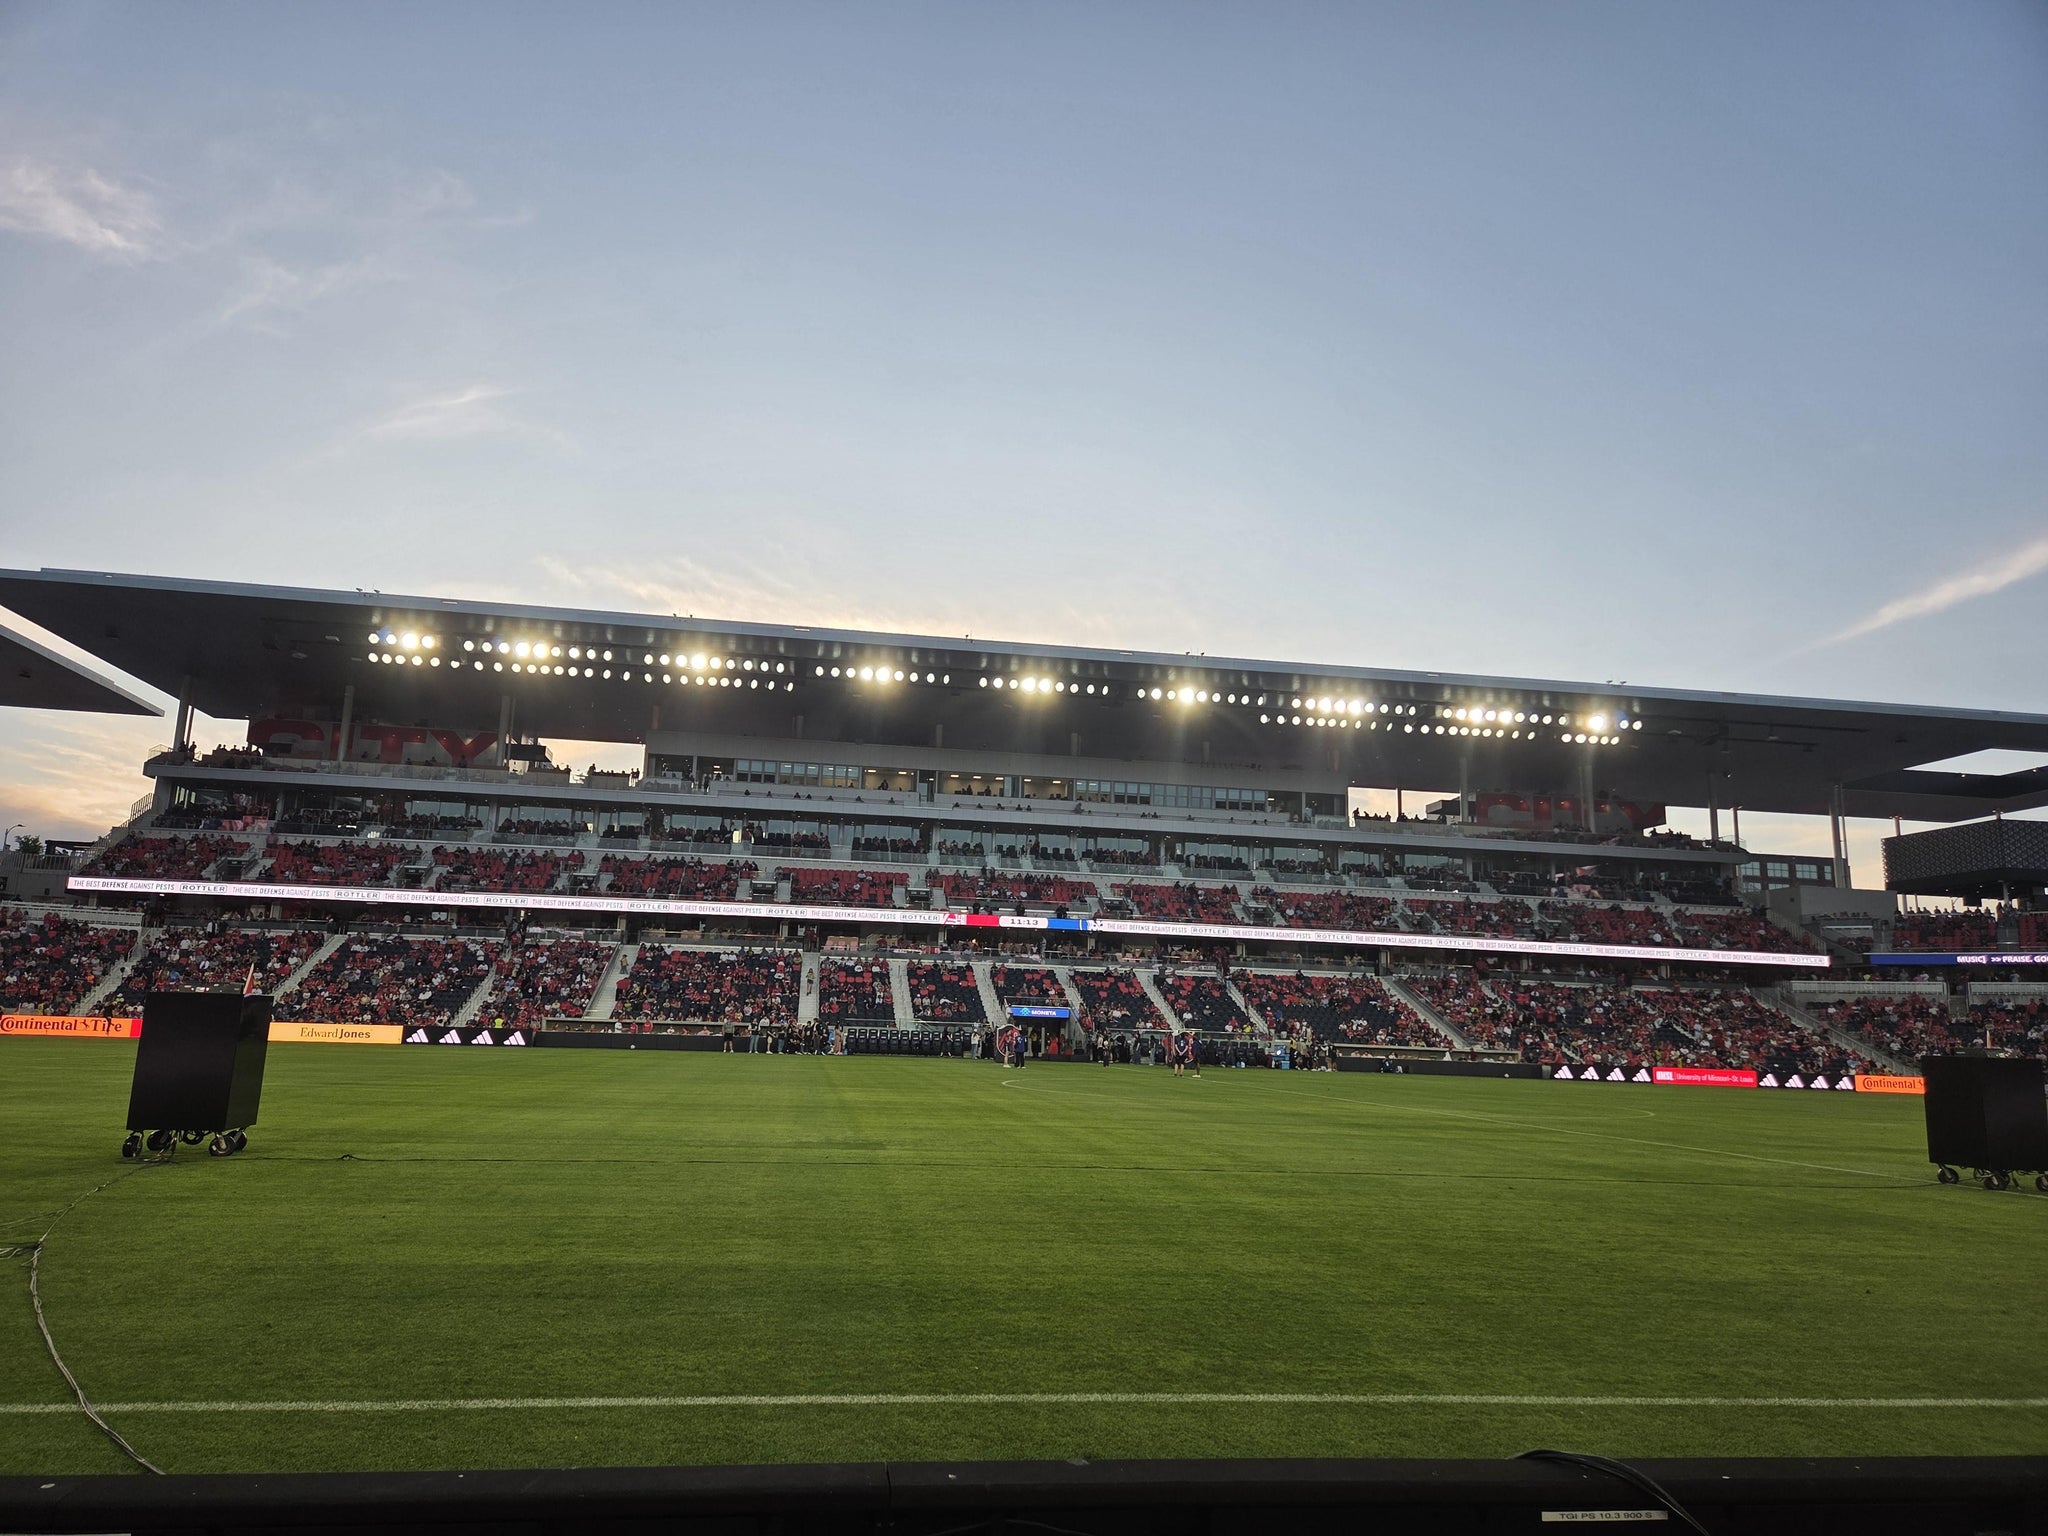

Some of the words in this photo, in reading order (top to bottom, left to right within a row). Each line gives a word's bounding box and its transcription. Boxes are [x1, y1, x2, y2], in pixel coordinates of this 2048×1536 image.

[248, 718, 498, 768] CITY
[182, 884, 224, 892] ROTTLER
[337, 891, 378, 899] ROTTLER
[768, 908, 805, 916] ROTTLER
[1193, 927, 1227, 935] ROTTLER
[2002, 955, 2033, 963] PRAISE.
[0, 1017, 77, 1032] Continental
[1677, 1074, 1701, 1082] University
[1863, 1077, 1915, 1090] Continental
